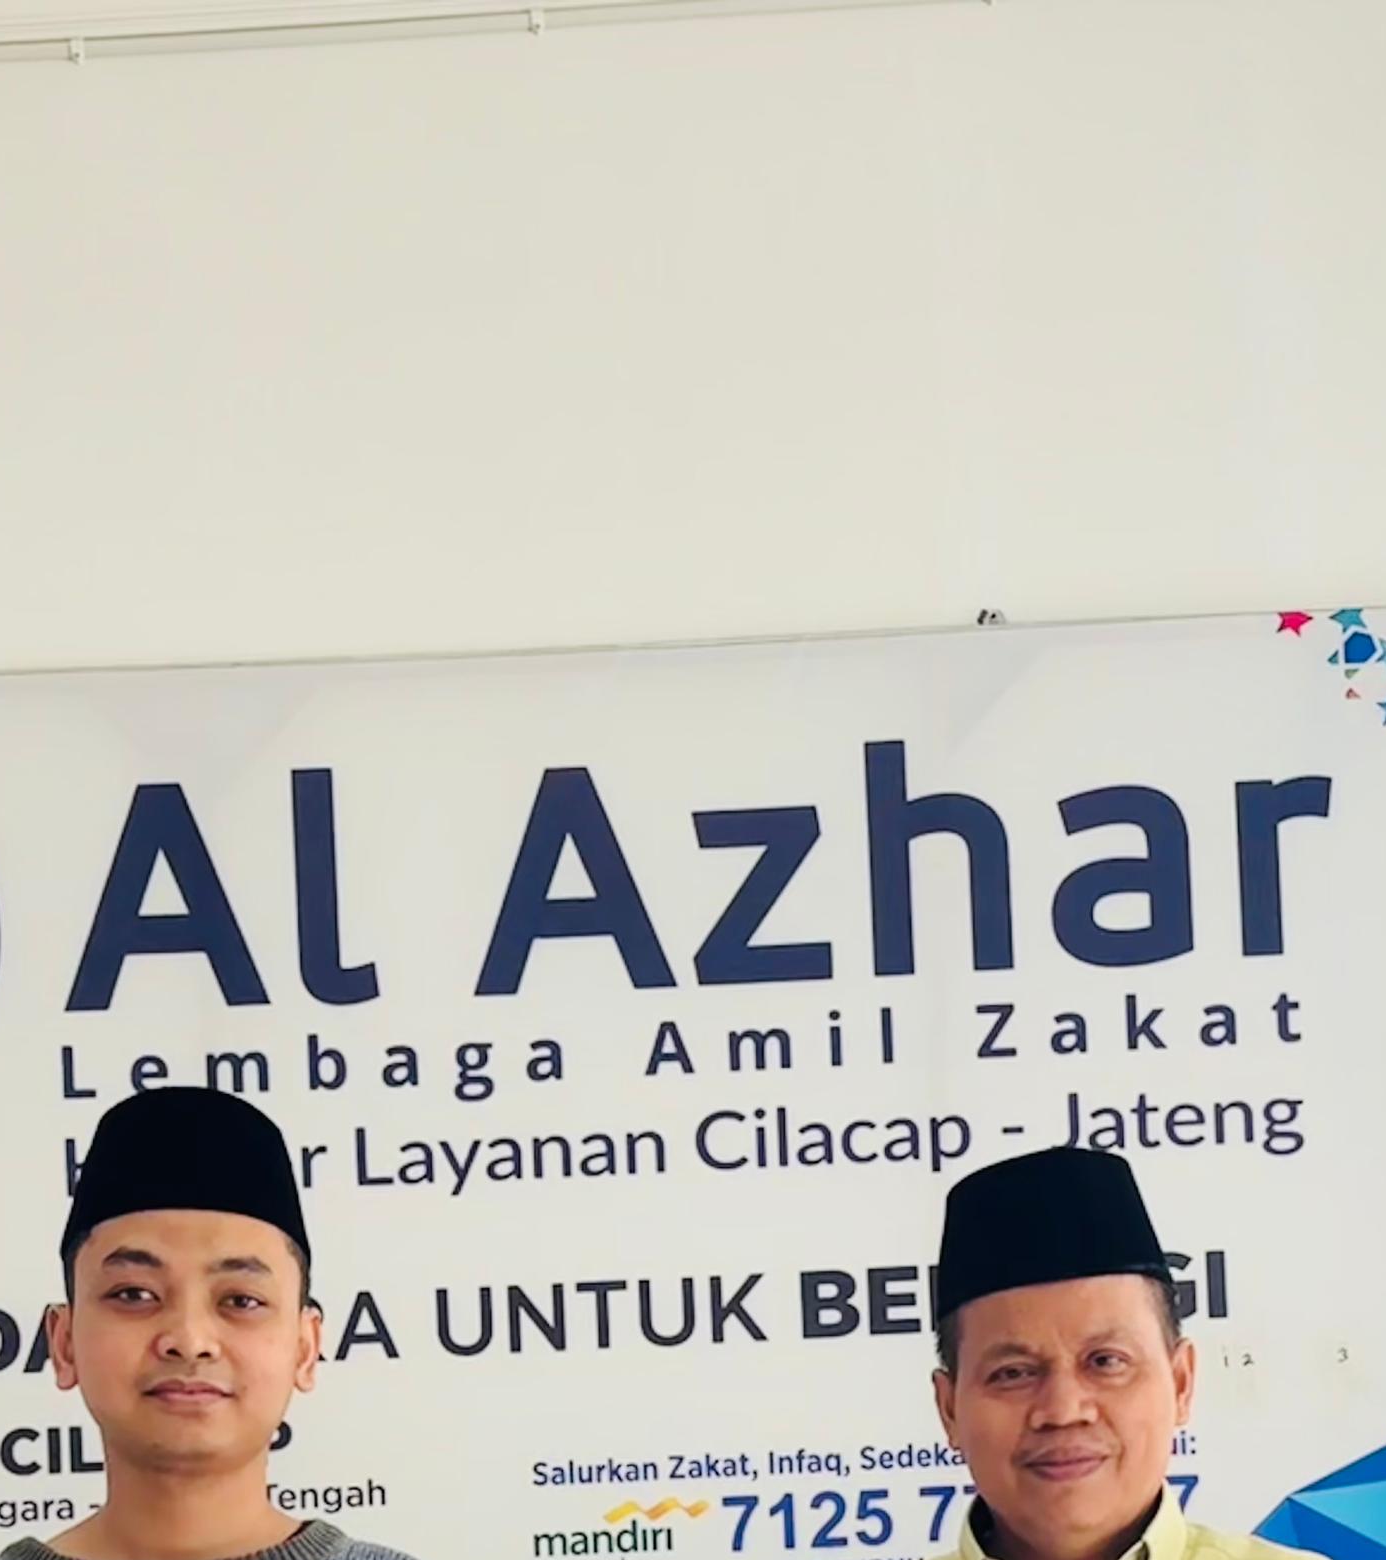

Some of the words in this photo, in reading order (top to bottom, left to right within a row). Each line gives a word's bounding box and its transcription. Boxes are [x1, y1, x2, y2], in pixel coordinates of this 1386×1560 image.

[64, 768, 380, 1012] Al
[475, 740, 1332, 996] Azhar
[61, 1034, 563, 1102] Lembaga
[645, 1006, 894, 1076] Amil
[976, 992, 1301, 1059] Zakat
[356, 1126, 666, 1197] Layanan
[695, 1107, 971, 1172] Cilacap
[1060, 1092, 1304, 1156] Jateng
[436, 1273, 768, 1356] UNTUK
[533, 1459, 659, 1487] Salurkan
[668, 1453, 760, 1482] Zakat,
[768, 1448, 852, 1477] Infaq,
[860, 1443, 966, 1470] Sedeka
[533, 1520, 675, 1558] mandiri
[722, 1487, 894, 1554] 7125
